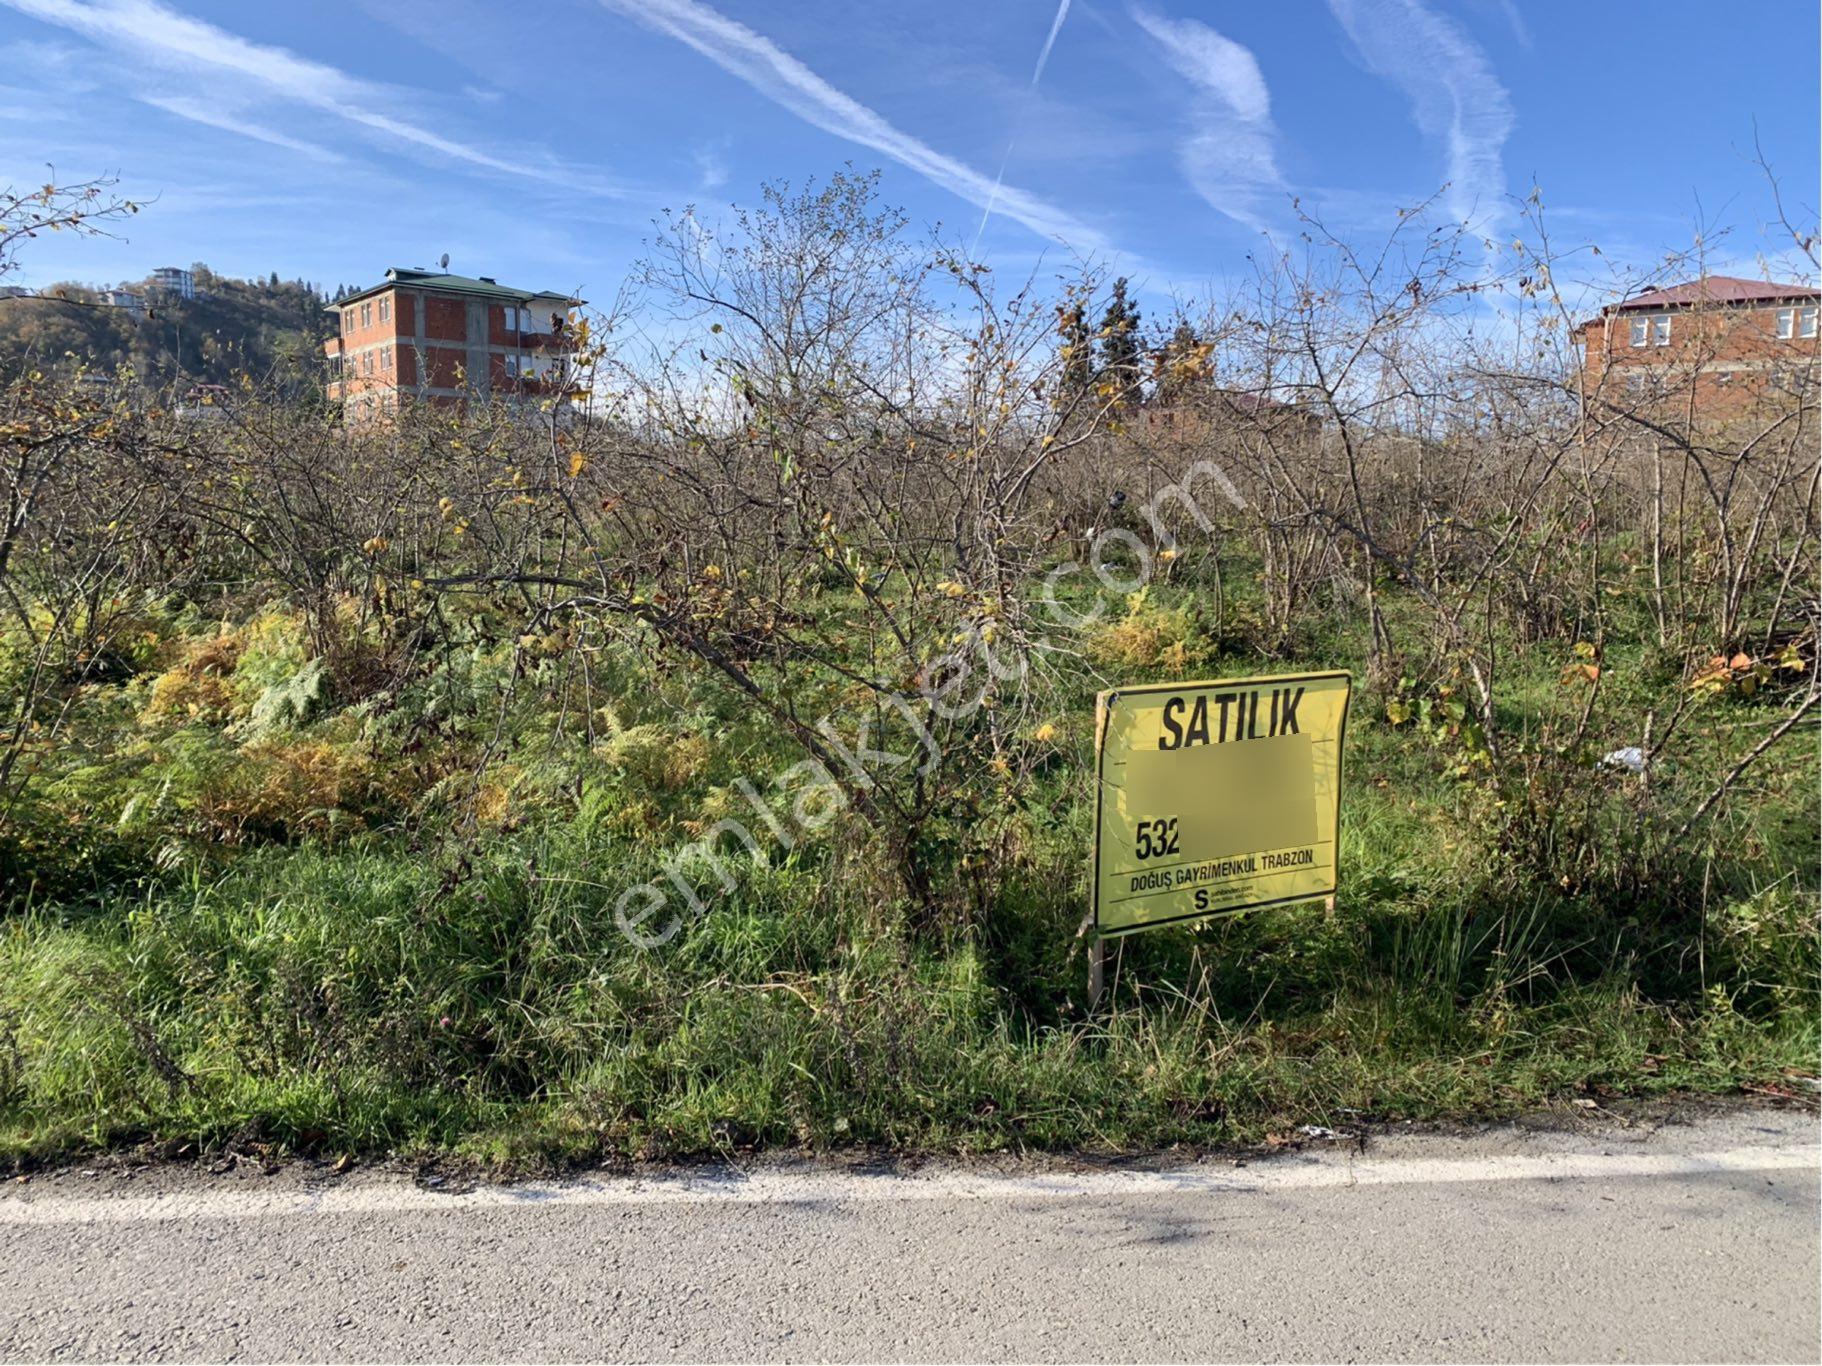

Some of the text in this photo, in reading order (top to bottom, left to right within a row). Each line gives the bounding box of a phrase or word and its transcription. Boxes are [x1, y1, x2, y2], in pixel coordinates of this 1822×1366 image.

[1159, 687, 1305, 750] SATILIK
[1135, 817, 1180, 861] 532
[1131, 849, 1313, 891] DOĞUŞ GAYRİMENKUL TRABZON
